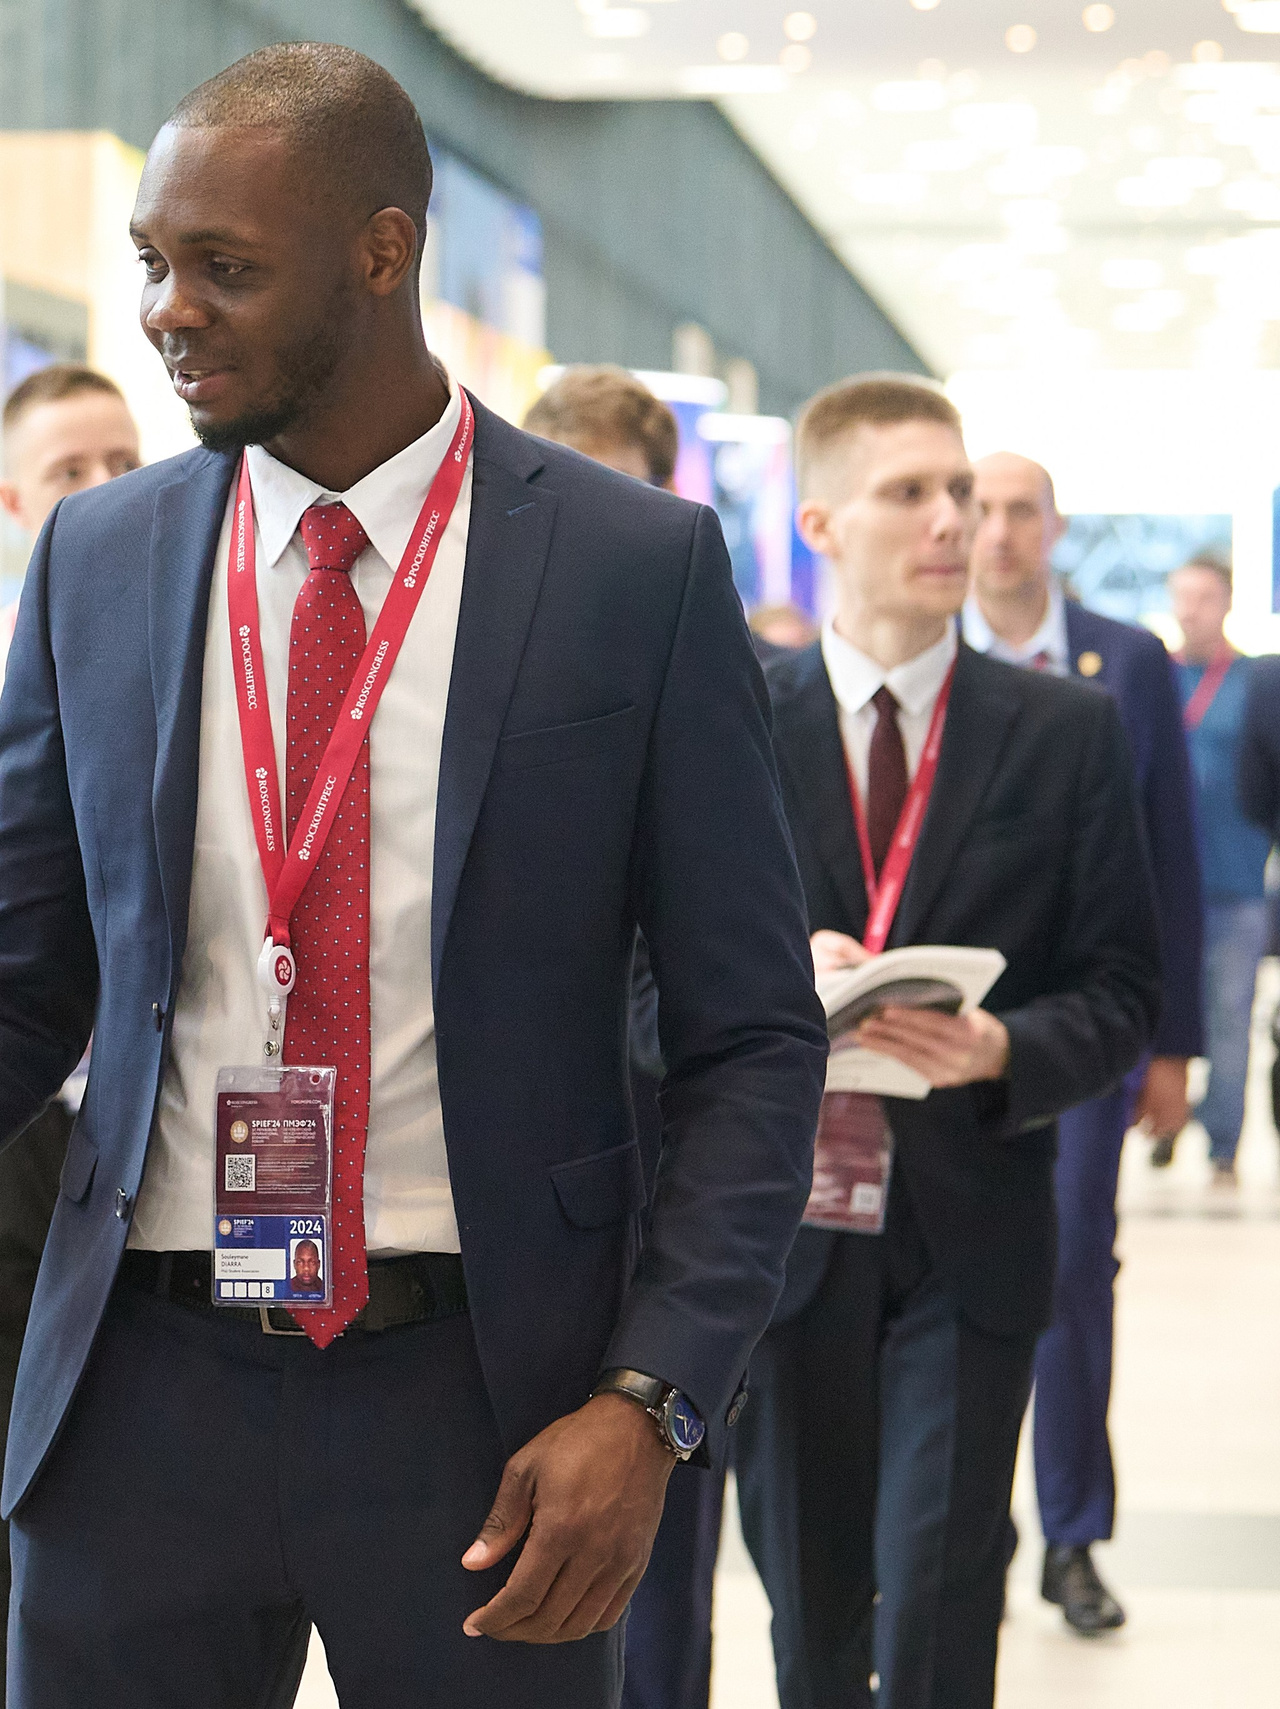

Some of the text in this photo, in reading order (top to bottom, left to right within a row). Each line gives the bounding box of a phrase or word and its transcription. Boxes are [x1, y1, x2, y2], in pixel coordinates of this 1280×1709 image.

[237, 510, 245, 573] ROSCONGRESS
[408, 510, 440, 577] РОСКОНГРЕСС
[241, 637, 258, 710] РОСКОНГРЕСС
[355, 640, 390, 709] ROSCONGRESS
[258, 779, 276, 852] ROSCONGRESS
[303, 775, 337, 849] РОСКОНГРЕСС
[252, 1120, 281, 1128] SPIEF'24
[283, 1120, 316, 1128] ПМЭФ'24
[290, 1220, 322, 1234] 2024
[266, 1286, 271, 1294] 8
